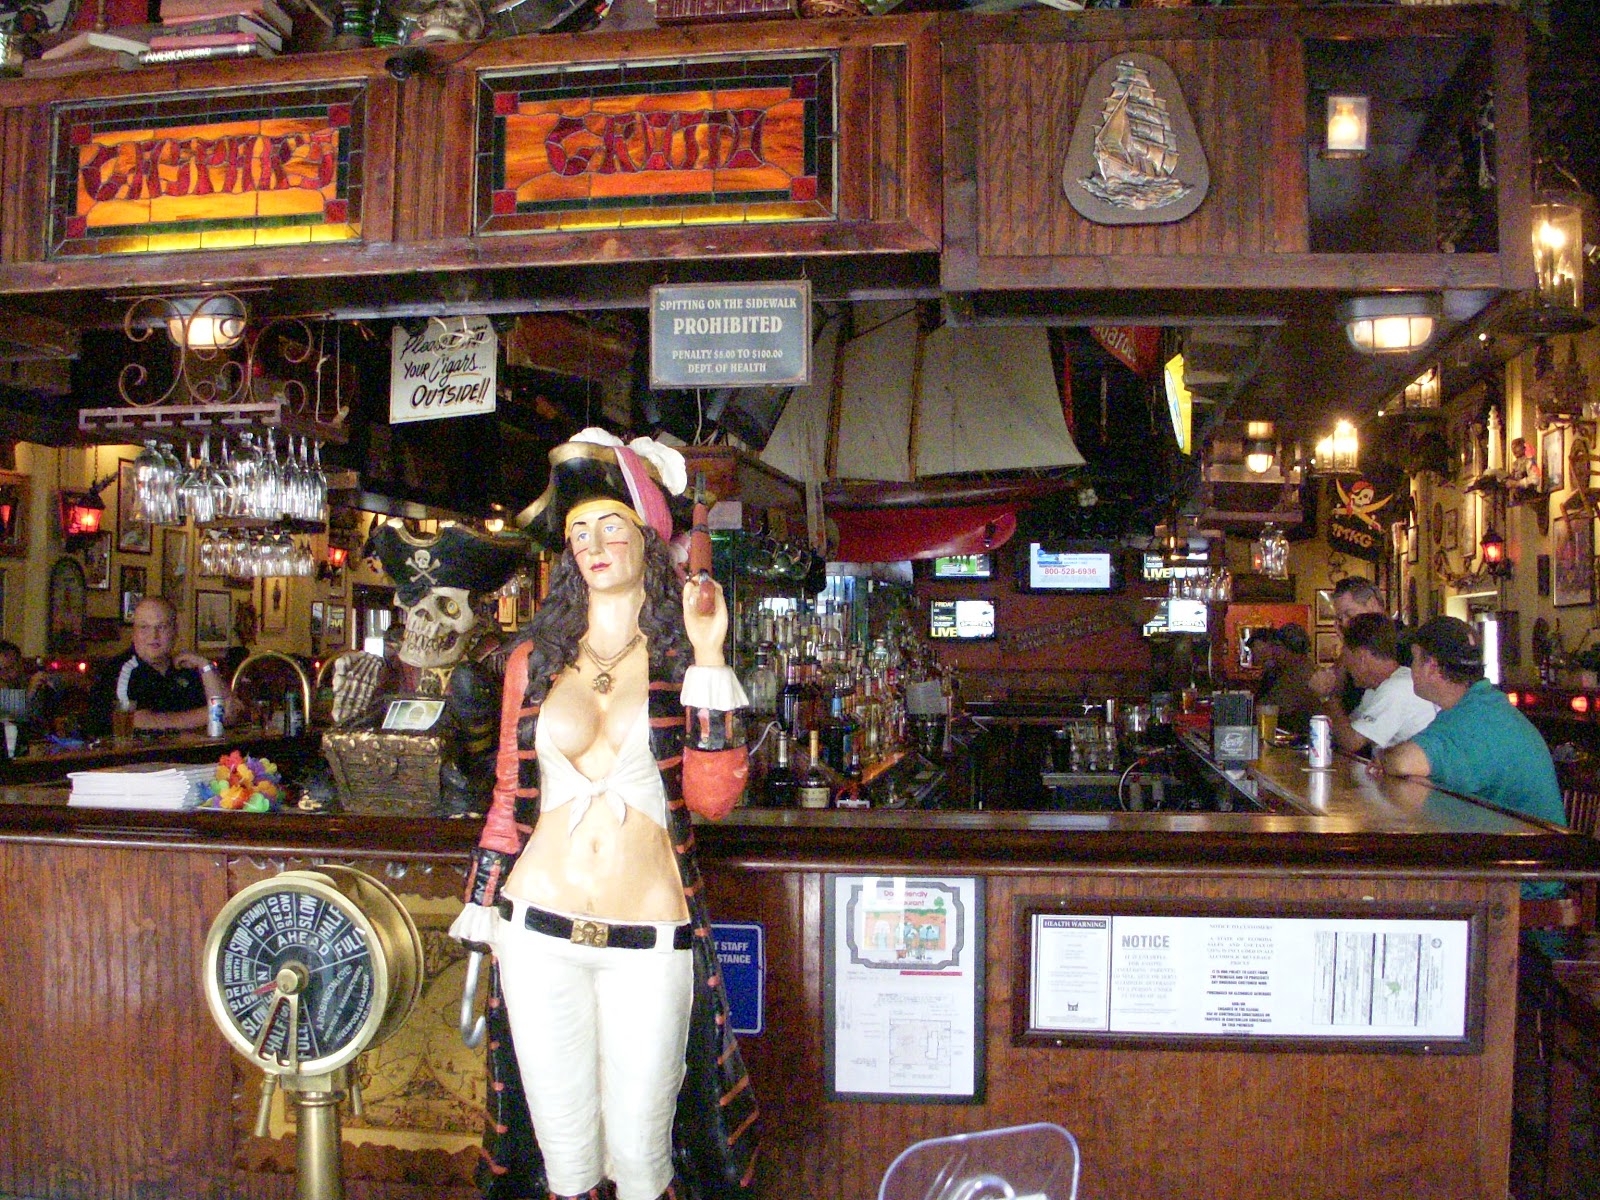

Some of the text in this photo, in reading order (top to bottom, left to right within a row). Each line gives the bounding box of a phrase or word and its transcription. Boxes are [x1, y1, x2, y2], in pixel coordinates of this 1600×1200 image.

[545, 109, 766, 177] GROTTO
[660, 297, 797, 310] SPITTING ON THE SIDEWALK
[673, 316, 783, 335] PROHIBITED
[672, 349, 713, 360] PENALTY
[737, 348, 750, 358] TO
[752, 349, 783, 359] $100.00
[688, 362, 766, 373] DEPT. OF HEALTH
[1144, 567, 1170, 579] LIVE
[931, 627, 957, 637] LIVE
[241, 903, 266, 927] STAND
[267, 896, 285, 930] DEAD
[280, 894, 294, 927] SLOW
[299, 894, 319, 929] SLOW
[254, 919, 271, 937] BY
[318, 904, 345, 940] HALF
[229, 926, 254, 955] STOP
[334, 929, 366, 957] FULL
[721, 941, 749, 951] STAFF
[1121, 935, 1170, 948] NOTICE
[716, 953, 752, 964] STANCE
[225, 984, 254, 999] DEAD
[229, 993, 258, 1012] SLOW
[241, 1002, 268, 1037] SLOW
[265, 1018, 289, 1052] HALF
[298, 1025, 312, 1060] FULL
